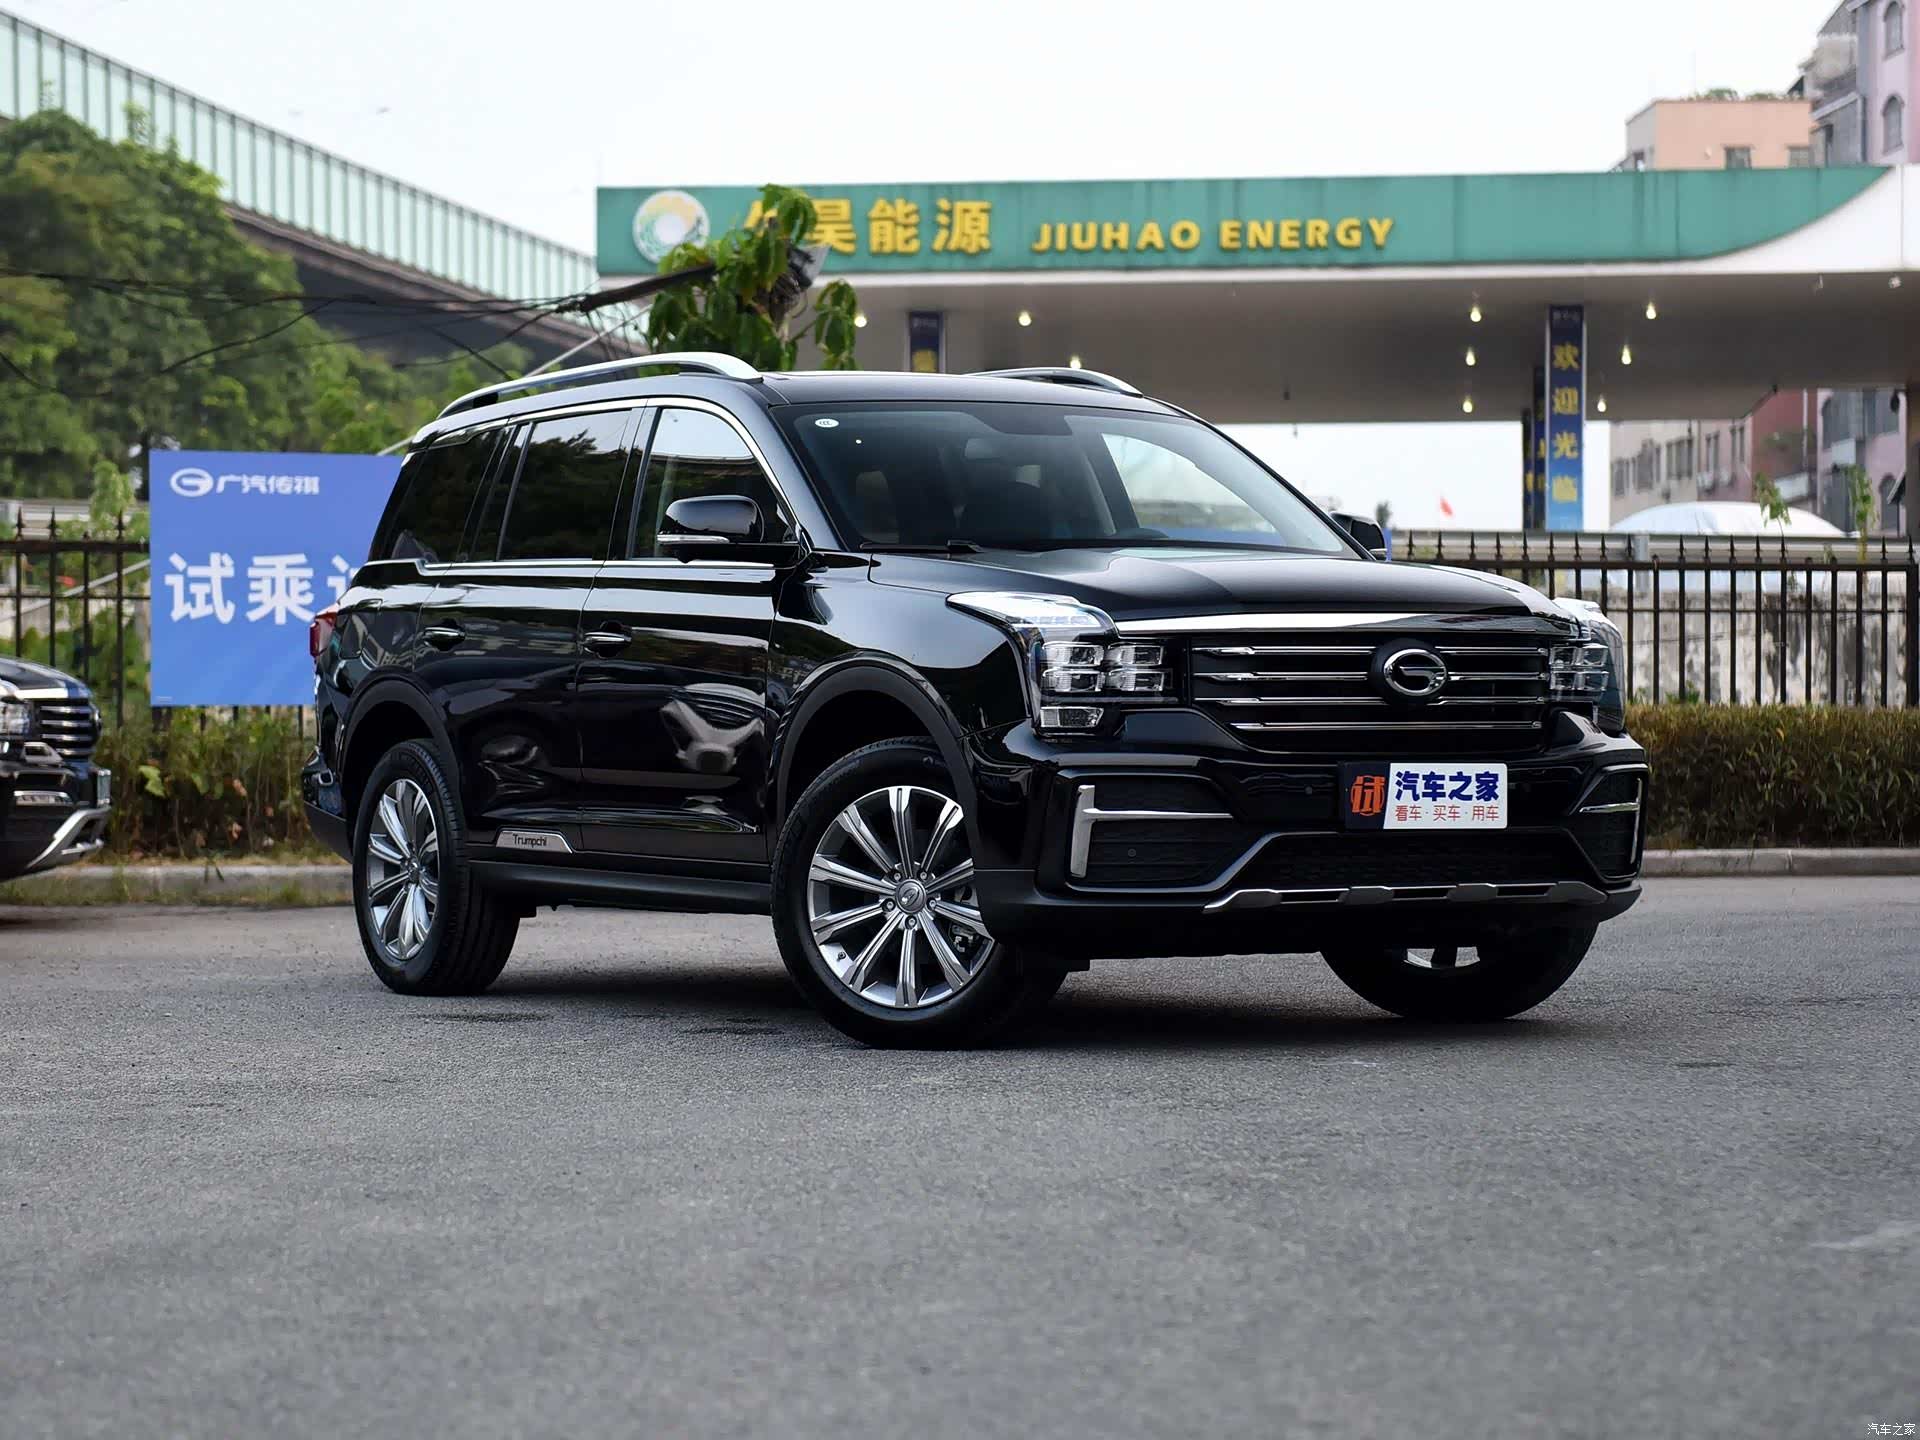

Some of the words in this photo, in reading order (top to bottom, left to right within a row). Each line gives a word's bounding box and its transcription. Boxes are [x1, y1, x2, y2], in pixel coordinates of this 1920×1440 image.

[1032, 221, 1200, 251] JIUHAO
[1219, 218, 1394, 249] ENERGY
[1395, 771, 1499, 802] 汽车之家
